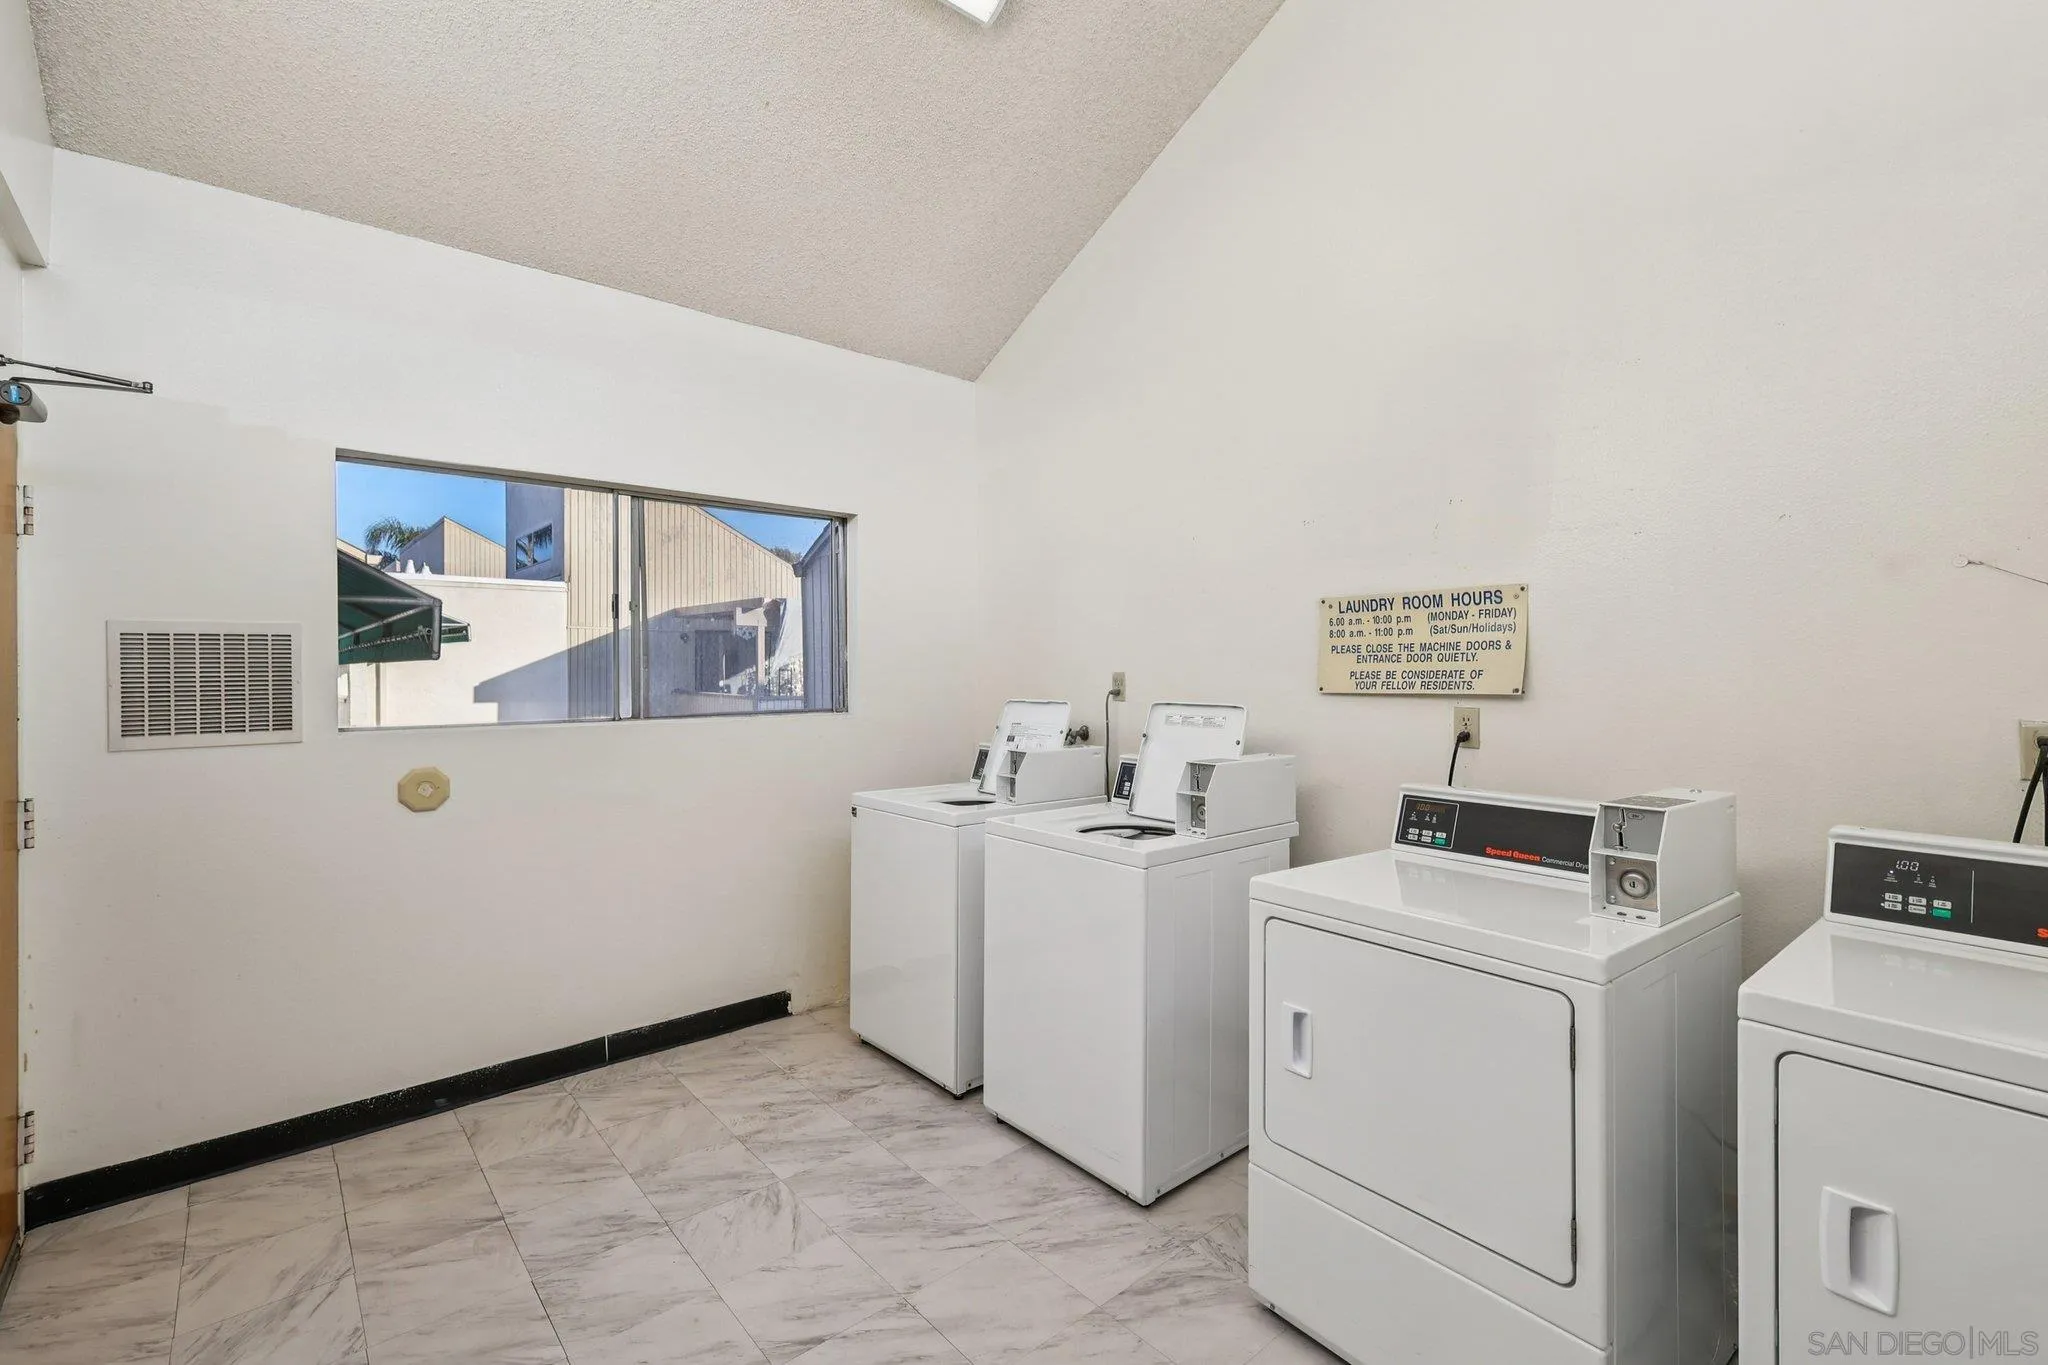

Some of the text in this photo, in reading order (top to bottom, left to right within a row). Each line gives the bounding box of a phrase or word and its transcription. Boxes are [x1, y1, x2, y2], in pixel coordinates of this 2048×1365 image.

[1338, 589, 1503, 614] LAUNDRY ROOM HOURS
[1348, 617, 1365, 626] a.m.
[1372, 615, 1392, 625] 10:00
[1396, 615, 1412, 626] p.m
[1427, 610, 1469, 624] (MONDAY
[1478, 607, 1517, 619] FRIDAY)
[1329, 629, 1345, 638] 8:00
[1349, 629, 1366, 638] a.m.
[1374, 627, 1393, 637] 11:00
[1397, 627, 1413, 638] p.m
[1429, 621, 1516, 637] (Sat/Sun/Holidays)
[1331, 639, 1512, 654] PLEASE CLOSE THE MACHINE DOORS &
[1356, 652, 1479, 664] ENTRANCE DOOR QUIETLY.
[1349, 669, 1484, 680] PLEASE BE CONSIDERATE OF
[1355, 680, 1475, 690] YOUR FELLOW RESIDENTS.
[1485, 846, 1512, 857] Speed
[1512, 850, 1540, 862] Queen
[1541, 856, 1575, 867] Commercial
